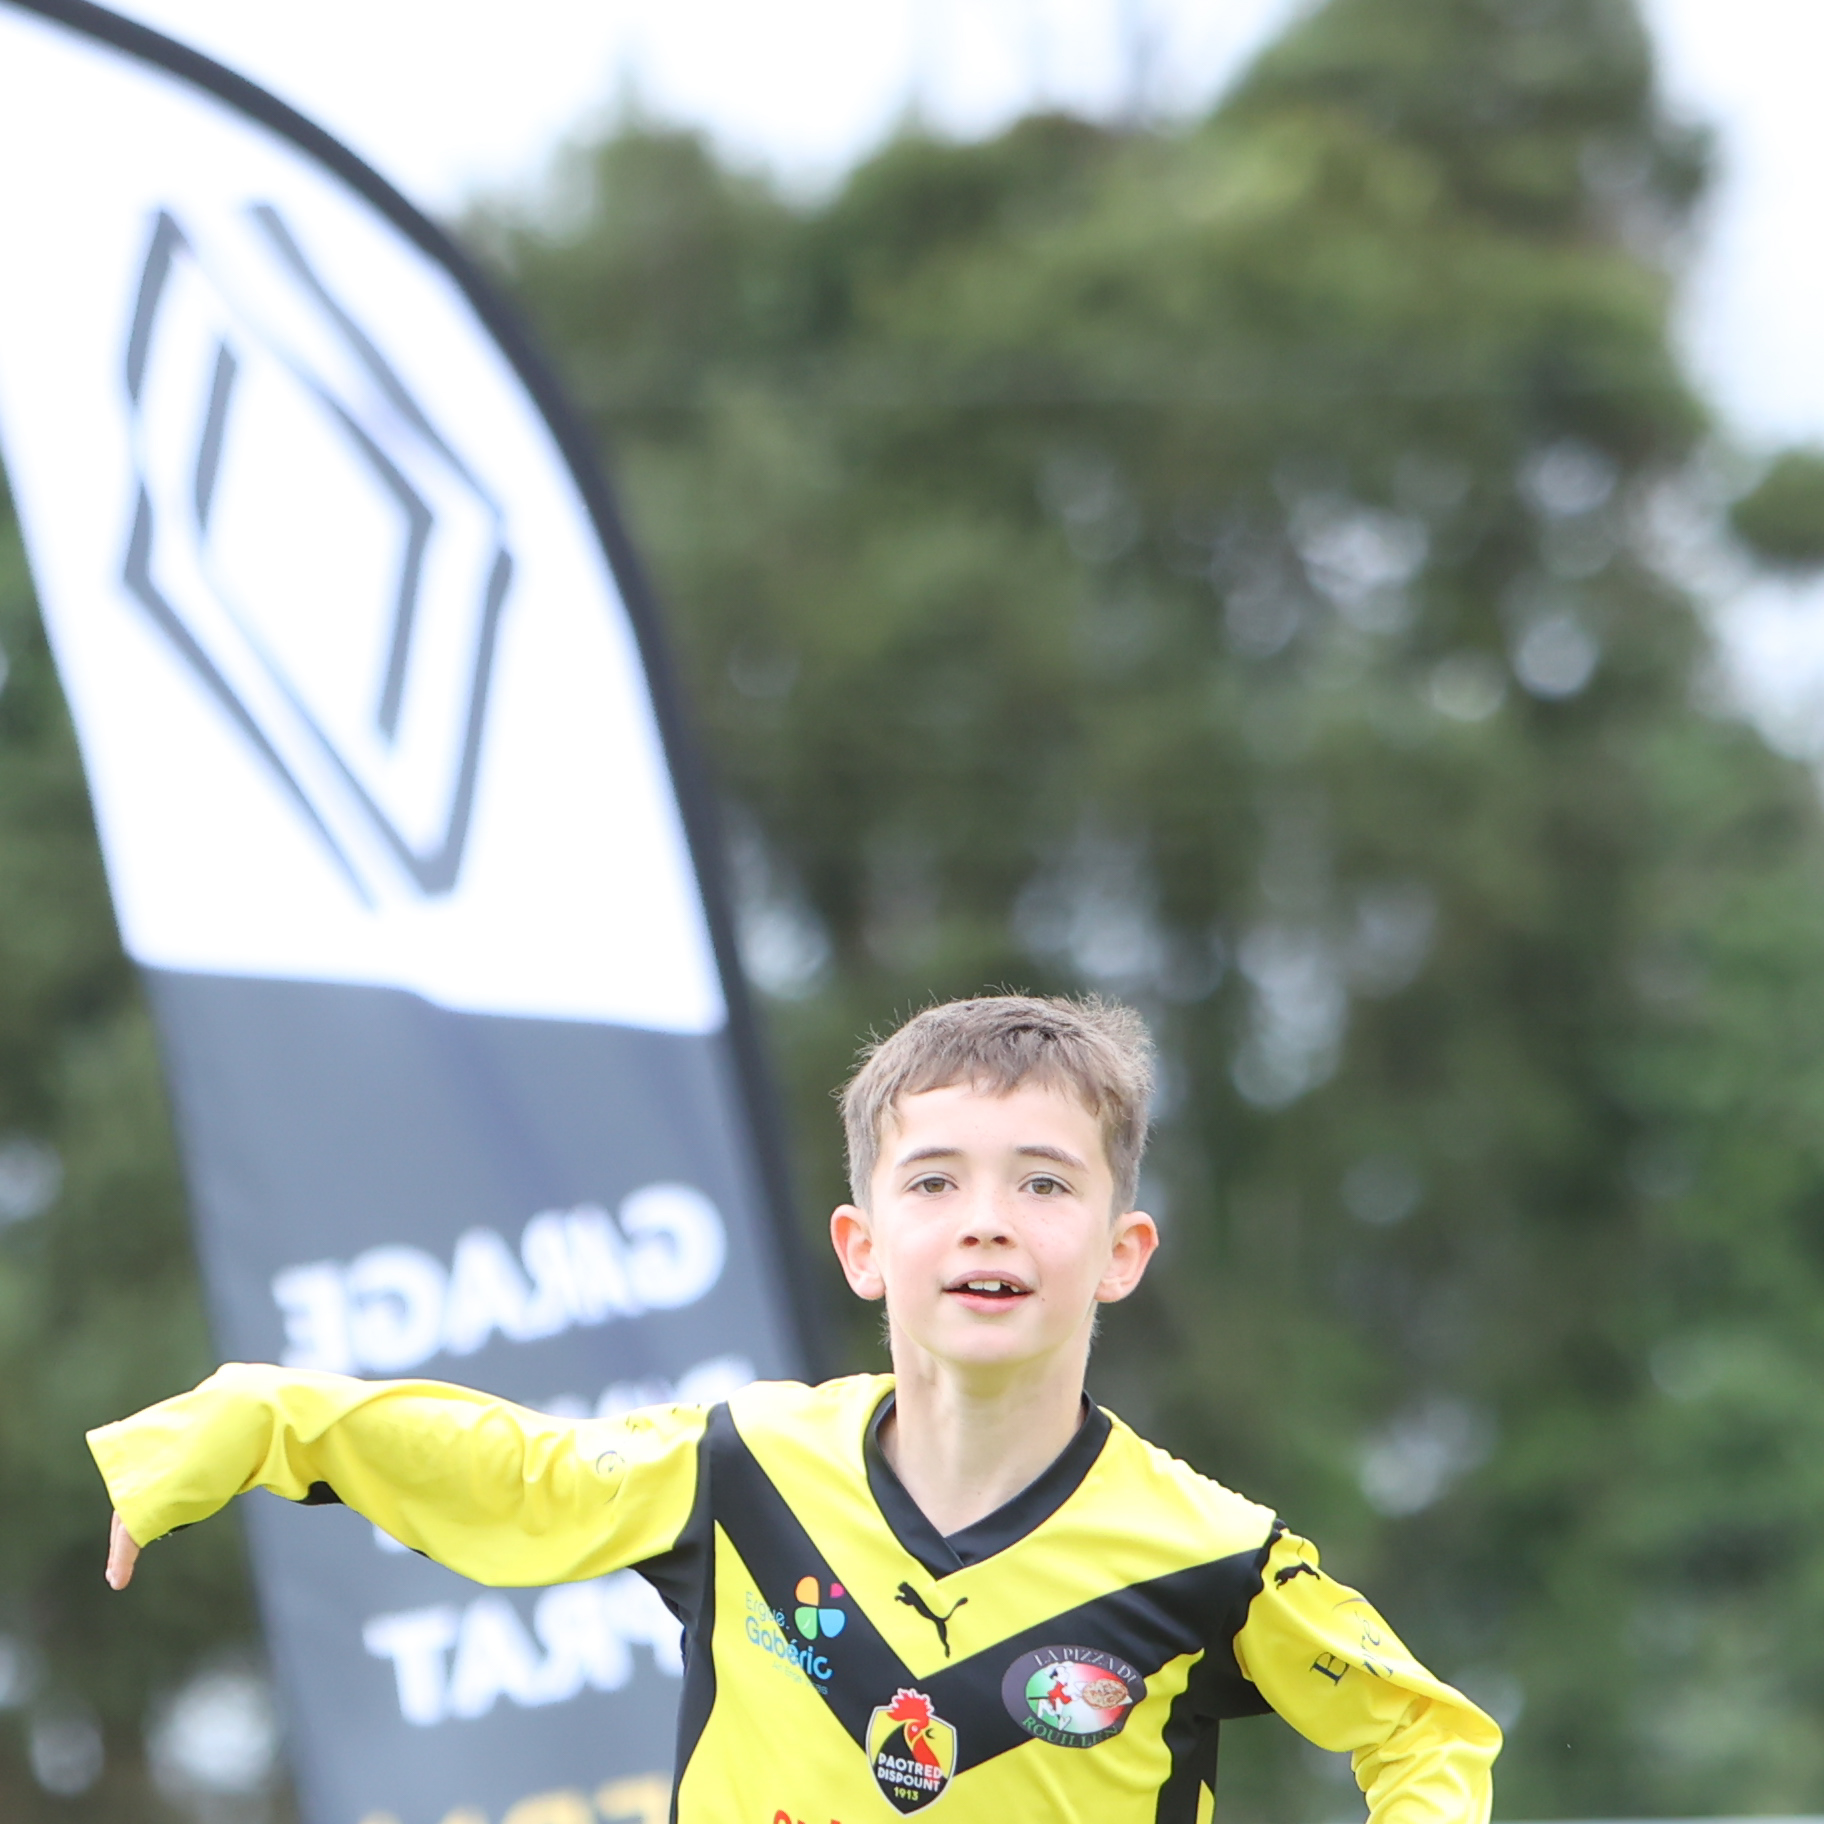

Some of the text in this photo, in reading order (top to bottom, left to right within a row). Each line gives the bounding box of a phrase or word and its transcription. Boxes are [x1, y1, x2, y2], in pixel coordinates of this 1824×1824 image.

[745, 1615, 833, 1680] Gabéric
[1034, 1648, 1137, 1683] LA PIZZA DI
[1022, 1716, 1119, 1747] ROUILLEN
[877, 1766, 941, 1792] DISPOUNT
[878, 1753, 942, 1779] PAOTRED
[893, 1786, 919, 1801] 1913
